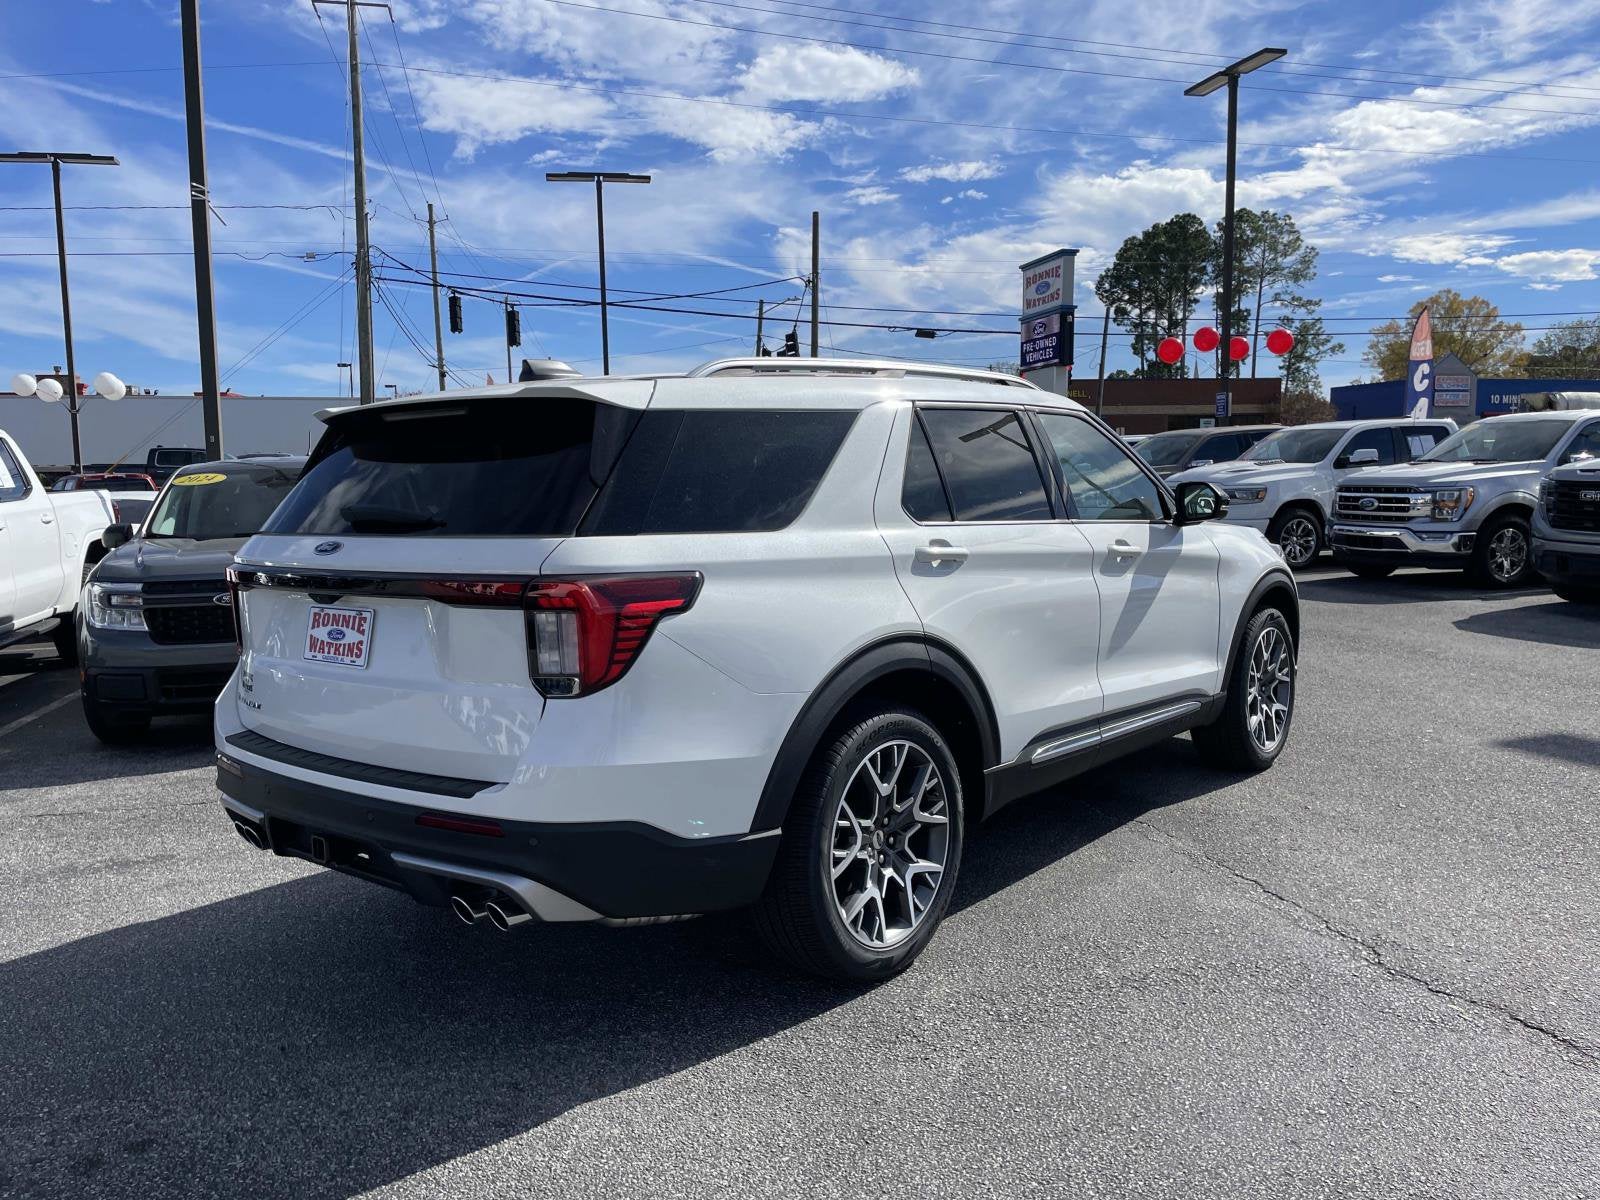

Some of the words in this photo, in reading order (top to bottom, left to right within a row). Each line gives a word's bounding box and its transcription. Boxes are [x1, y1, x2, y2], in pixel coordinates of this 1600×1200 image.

[1025, 265, 1061, 289] RONNIE
[1025, 288, 1061, 310] WATKINS
[1022, 336, 1057, 353] PRE-OWNED
[1025, 348, 1054, 363] VEHICLES
[1491, 394, 1500, 404] 10
[310, 611, 368, 637] RONNIE
[329, 630, 344, 640] Ford
[308, 633, 364, 659] WATKINS
